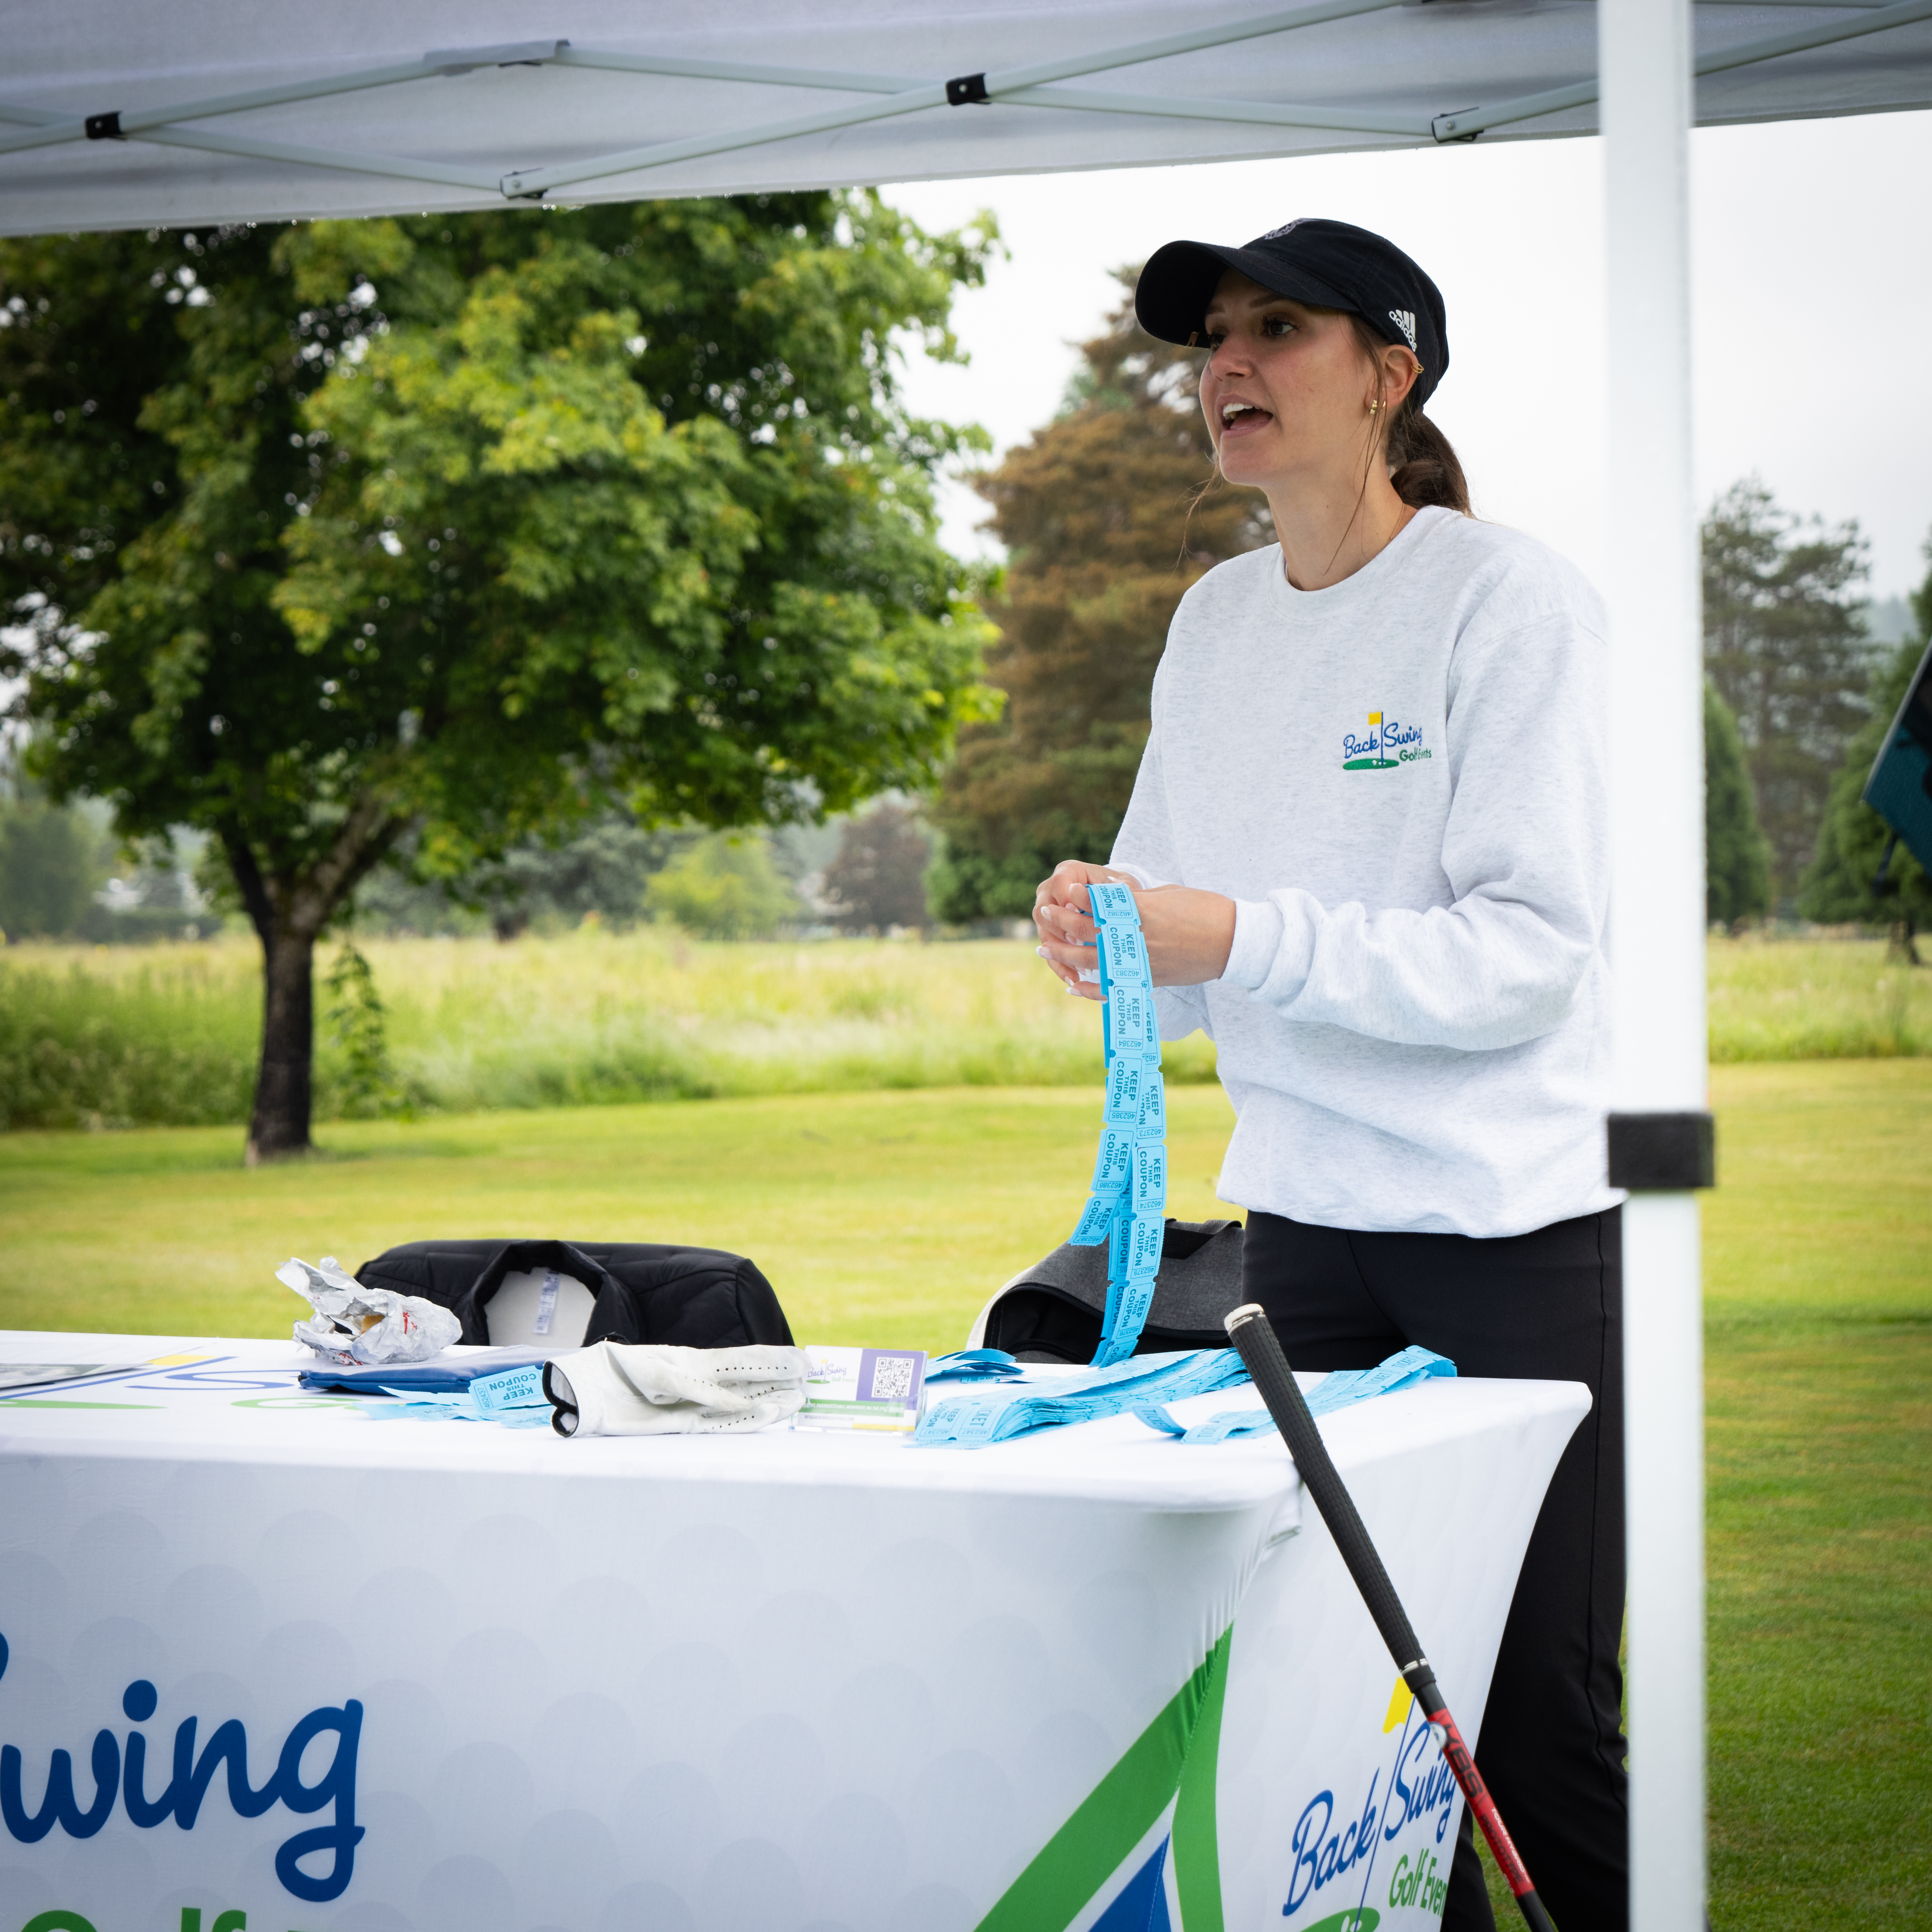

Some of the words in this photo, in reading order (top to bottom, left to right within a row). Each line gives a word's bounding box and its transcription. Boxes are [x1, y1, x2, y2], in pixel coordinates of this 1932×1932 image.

[1389, 311, 1416, 352] adidas
[1343, 731, 1379, 759] Back
[1384, 722, 1422, 747] Swing
[1099, 886, 1113, 908] COUPON
[1115, 888, 1126, 903] KEEP
[1110, 927, 1122, 966] COUPON
[1126, 934, 1136, 958] KEEP
[1117, 989, 1126, 1035] COUPON
[1132, 998, 1140, 1027] KEEP
[1113, 1061, 1125, 1108] COUPON
[1129, 1071, 1138, 1101] KEEP
[1150, 1085, 1159, 1115] KEEP
[1101, 1134, 1116, 1178] COUPON
[1117, 1143, 1129, 1171] KEEP
[1081, 1200, 1101, 1235] COUPON
[1093, 1212, 1102, 1225] THIS
[1097, 1208, 1112, 1229] KEEP
[1140, 1201, 1162, 1209] 462374
[1120, 1220, 1129, 1263] COUPON
[1135, 1222, 1145, 1266] COUPON
[1149, 1229, 1158, 1257] KEEP
[1134, 1267, 1154, 1276] 462375
[1122, 1289, 1136, 1328] COUPON
[1137, 1293, 1148, 1318] KEEP
[489, 1373, 536, 1391] COUPON
[808, 1367, 825, 1377] Back
[827, 1364, 847, 1376] Swing
[478, 1388, 490, 1408] 462437
[503, 1387, 533, 1400] KEEP
[926, 1405, 948, 1427] COUPON
[946, 1408, 961, 1422] KEEP
[970, 1405, 997, 1426] TICKET
[0, 1632, 365, 1902] wing
[1443, 1723, 1483, 1798] KBS
[1282, 1766, 1380, 1916] Back
[1384, 1720, 1457, 1843] Swing
[1479, 1813, 1523, 1884] PROTOTYPE
[1491, 1807, 1507, 1835] TOUR
[1505, 1837, 1525, 1872] HYBRID
[1389, 1848, 1429, 1908] Golf
